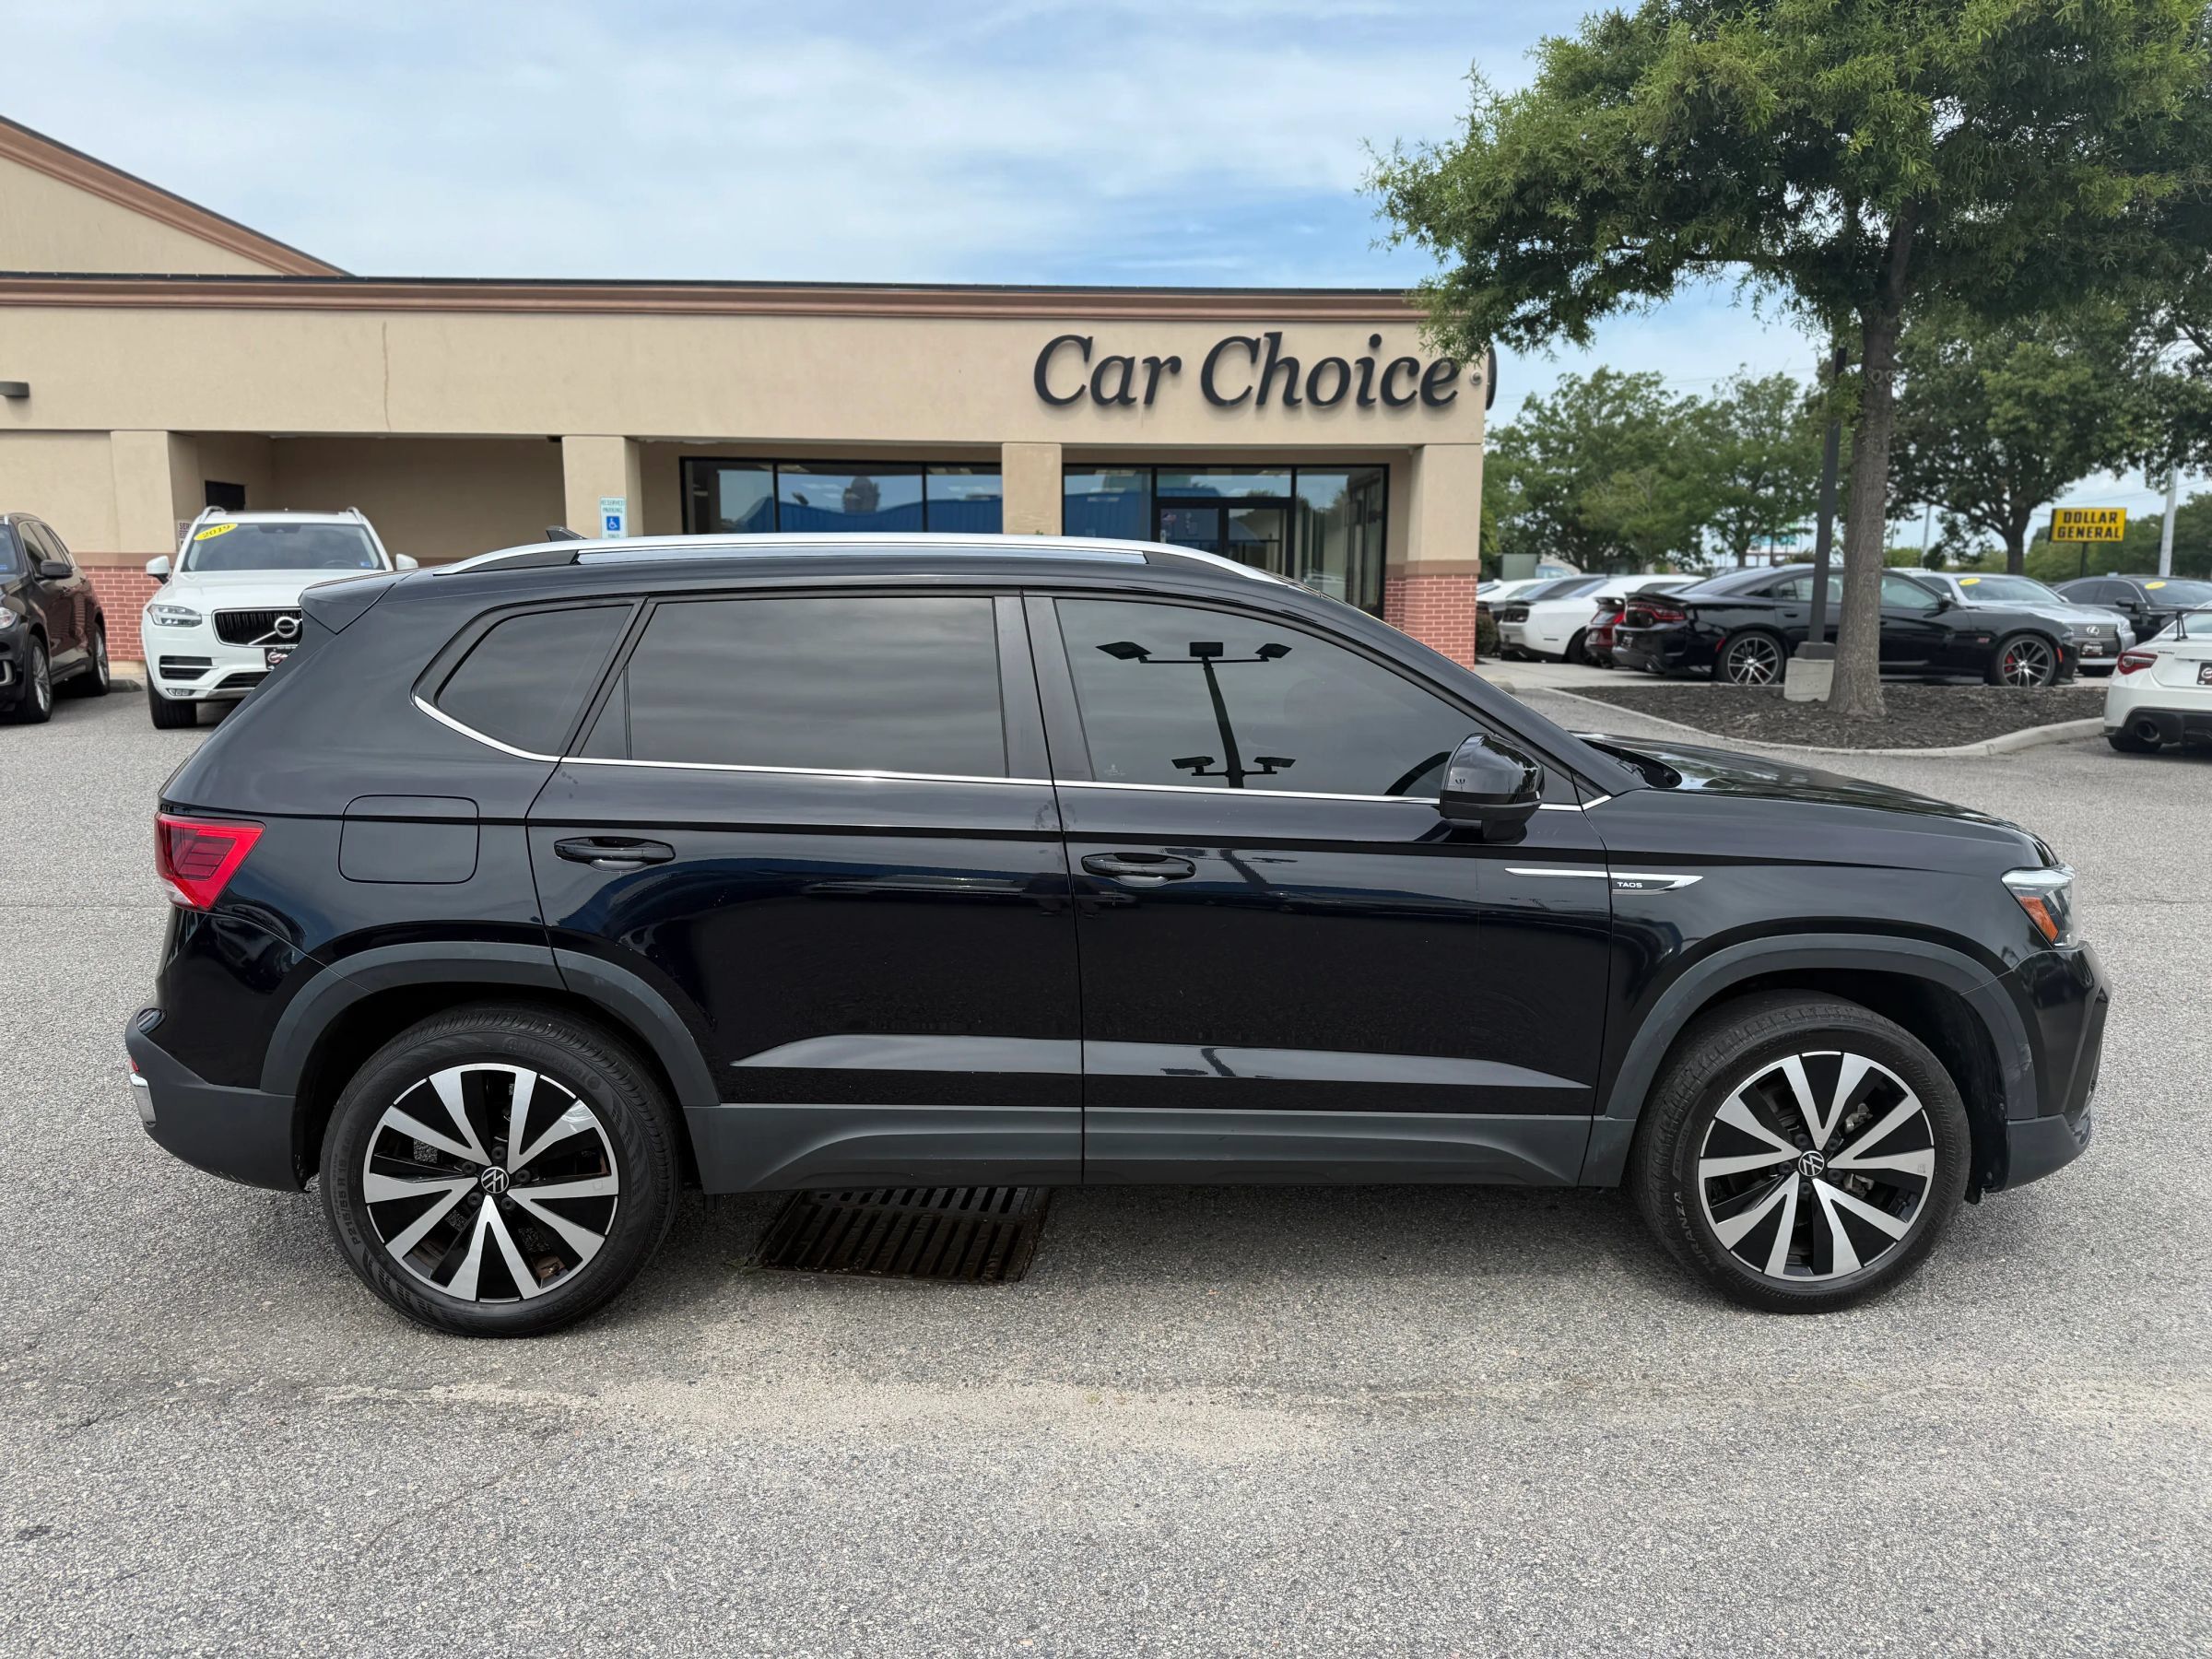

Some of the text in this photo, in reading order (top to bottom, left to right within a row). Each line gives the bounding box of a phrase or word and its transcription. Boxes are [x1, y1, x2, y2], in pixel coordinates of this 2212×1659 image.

[1034, 331, 1460, 406] Car Choice
[2057, 526, 2120, 538] GENERAL
[2064, 512, 2117, 524] DOLLAR
[1674, 1191, 1717, 1274] TURANZA
